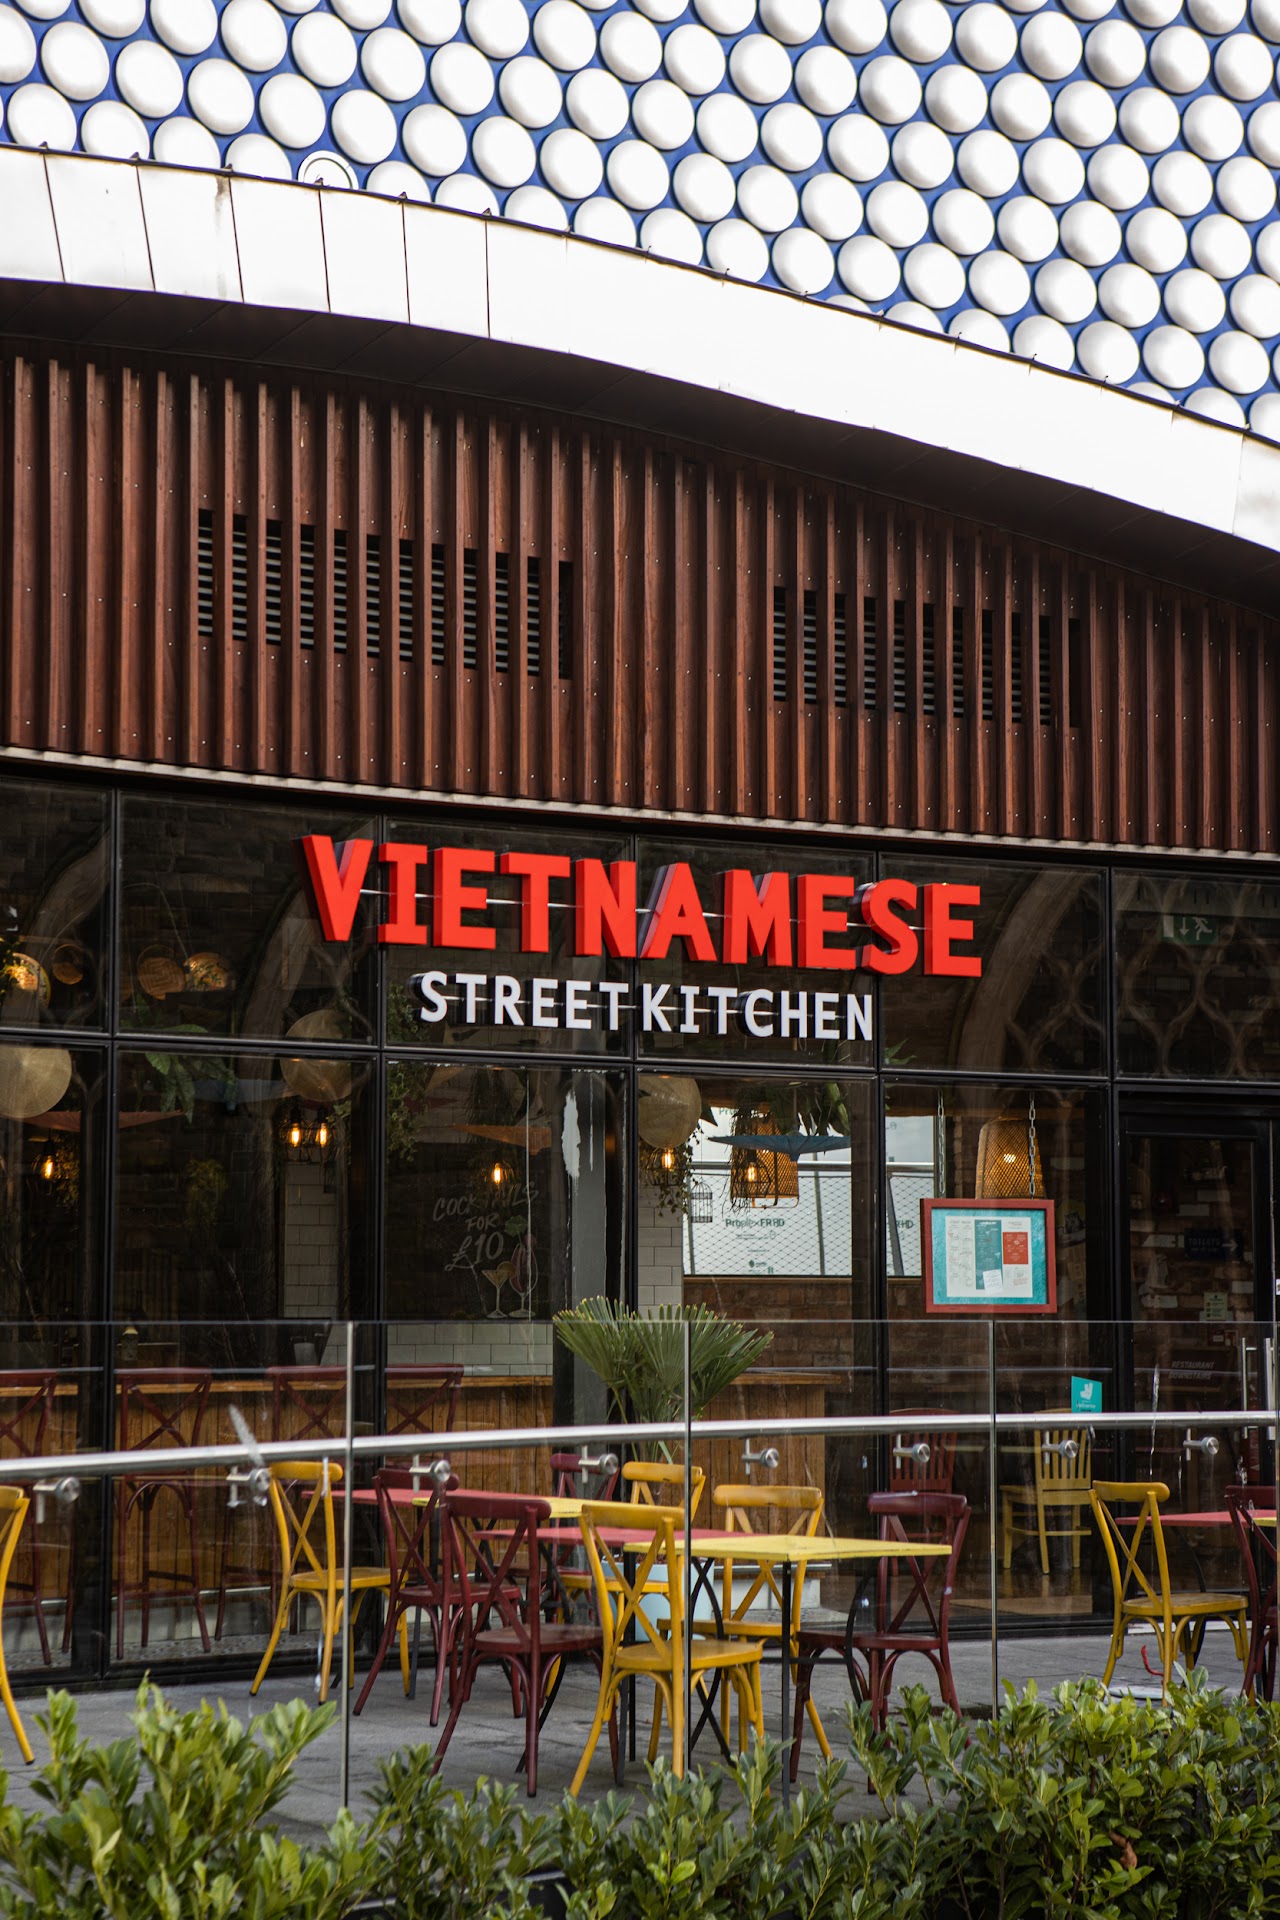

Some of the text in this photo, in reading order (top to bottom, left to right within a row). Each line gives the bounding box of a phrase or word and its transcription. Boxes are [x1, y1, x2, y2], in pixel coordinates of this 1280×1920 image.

[302, 834, 982, 977] VIETNAMESE
[419, 970, 873, 1041] STREET KITCHEN
[465, 1212, 500, 1232] FOR
[444, 1231, 504, 1272] £10
[1168, 1371, 1212, 1380] DOWNSTAIRS
[1171, 1360, 1215, 1370] RESTAURANT
